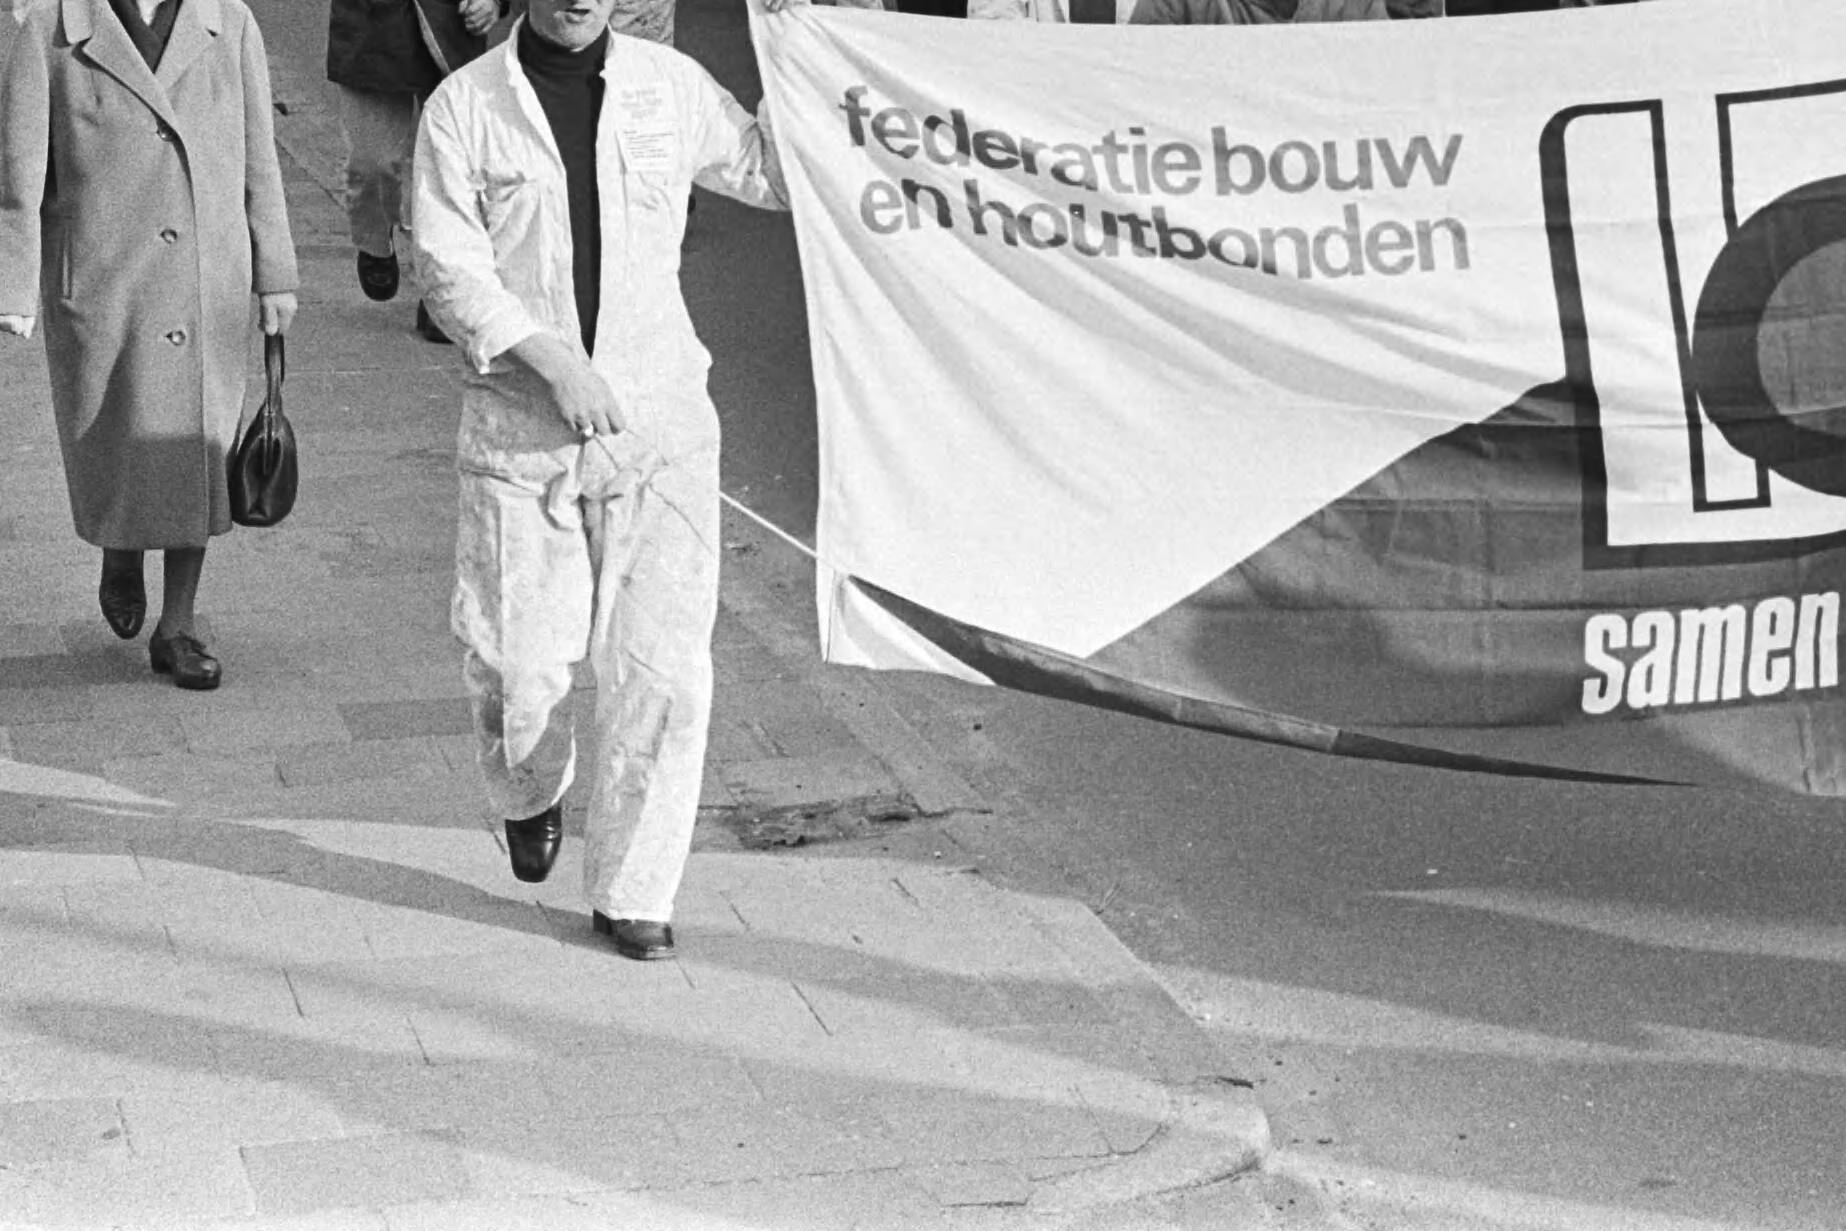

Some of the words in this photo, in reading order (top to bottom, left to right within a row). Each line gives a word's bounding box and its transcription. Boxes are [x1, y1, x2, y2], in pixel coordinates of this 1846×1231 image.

[838, 85, 1202, 196] federatie
[1211, 125, 1463, 197] bouw
[861, 176, 953, 234] en
[963, 178, 1471, 279] houtbonden
[1581, 590, 1841, 715] samen
